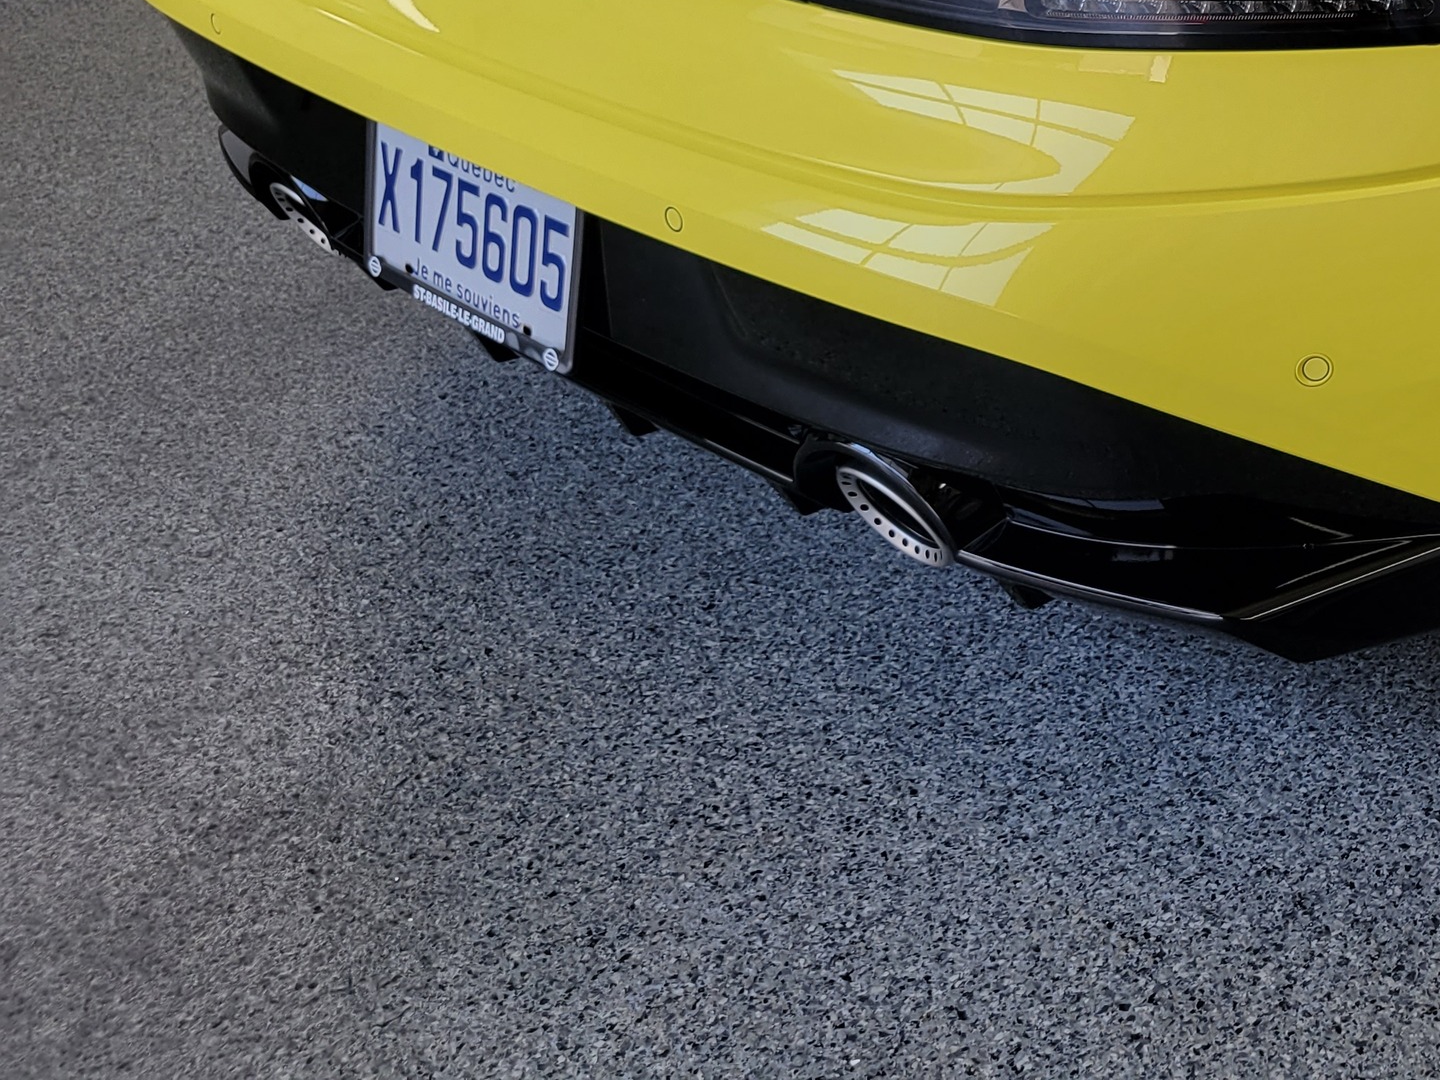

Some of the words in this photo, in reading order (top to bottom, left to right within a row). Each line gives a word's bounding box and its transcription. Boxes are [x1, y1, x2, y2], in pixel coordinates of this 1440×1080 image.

[378, 141, 570, 312] X175605
[413, 258, 428, 281] Je
[433, 271, 452, 293] me
[457, 283, 521, 329] souviens
